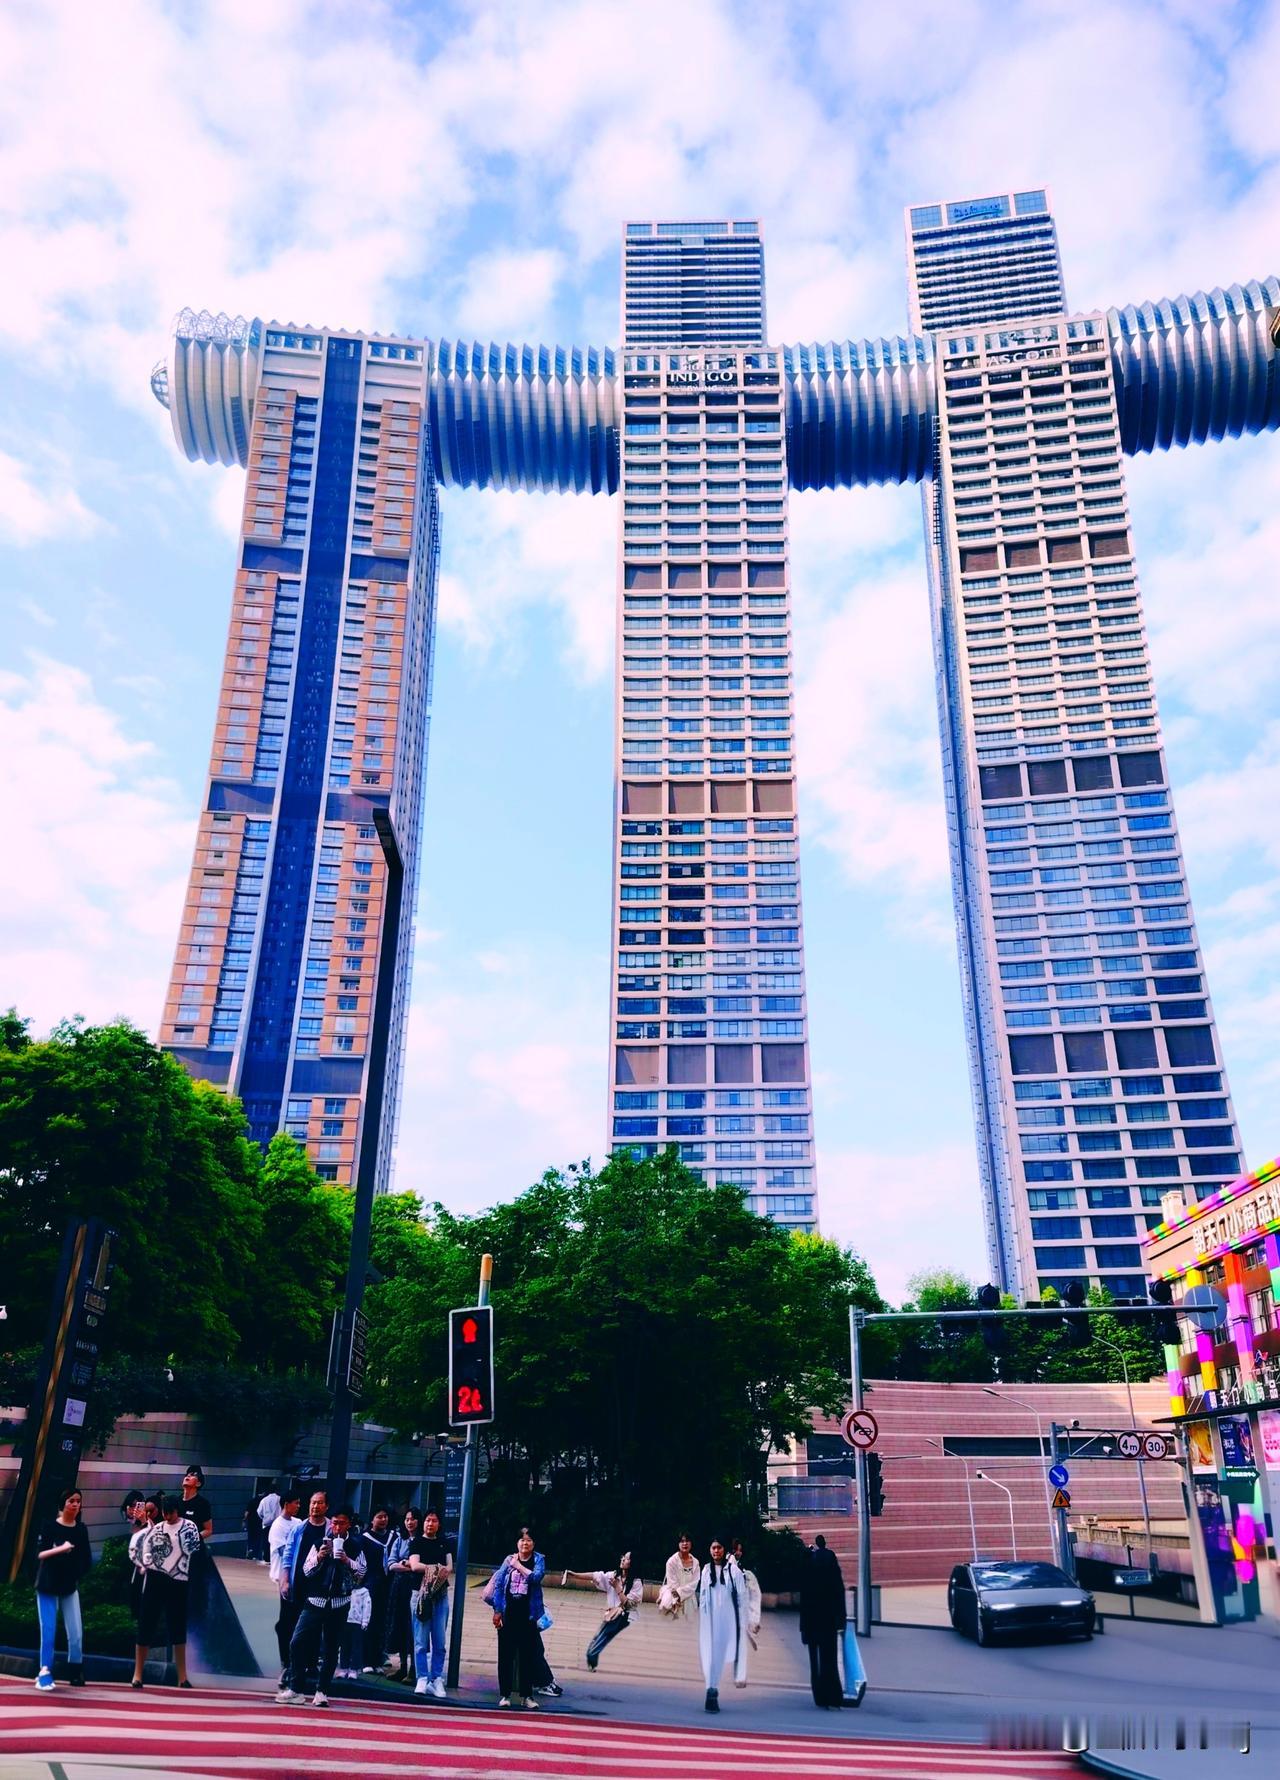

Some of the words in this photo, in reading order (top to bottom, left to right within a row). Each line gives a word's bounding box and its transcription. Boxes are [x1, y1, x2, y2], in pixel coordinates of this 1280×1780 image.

[987, 347, 1060, 366] ASCOTT
[670, 371, 733, 381] INDIGO
[1122, 1439, 1138, 1450] 4m
[1148, 1442, 1164, 1452] 30t
